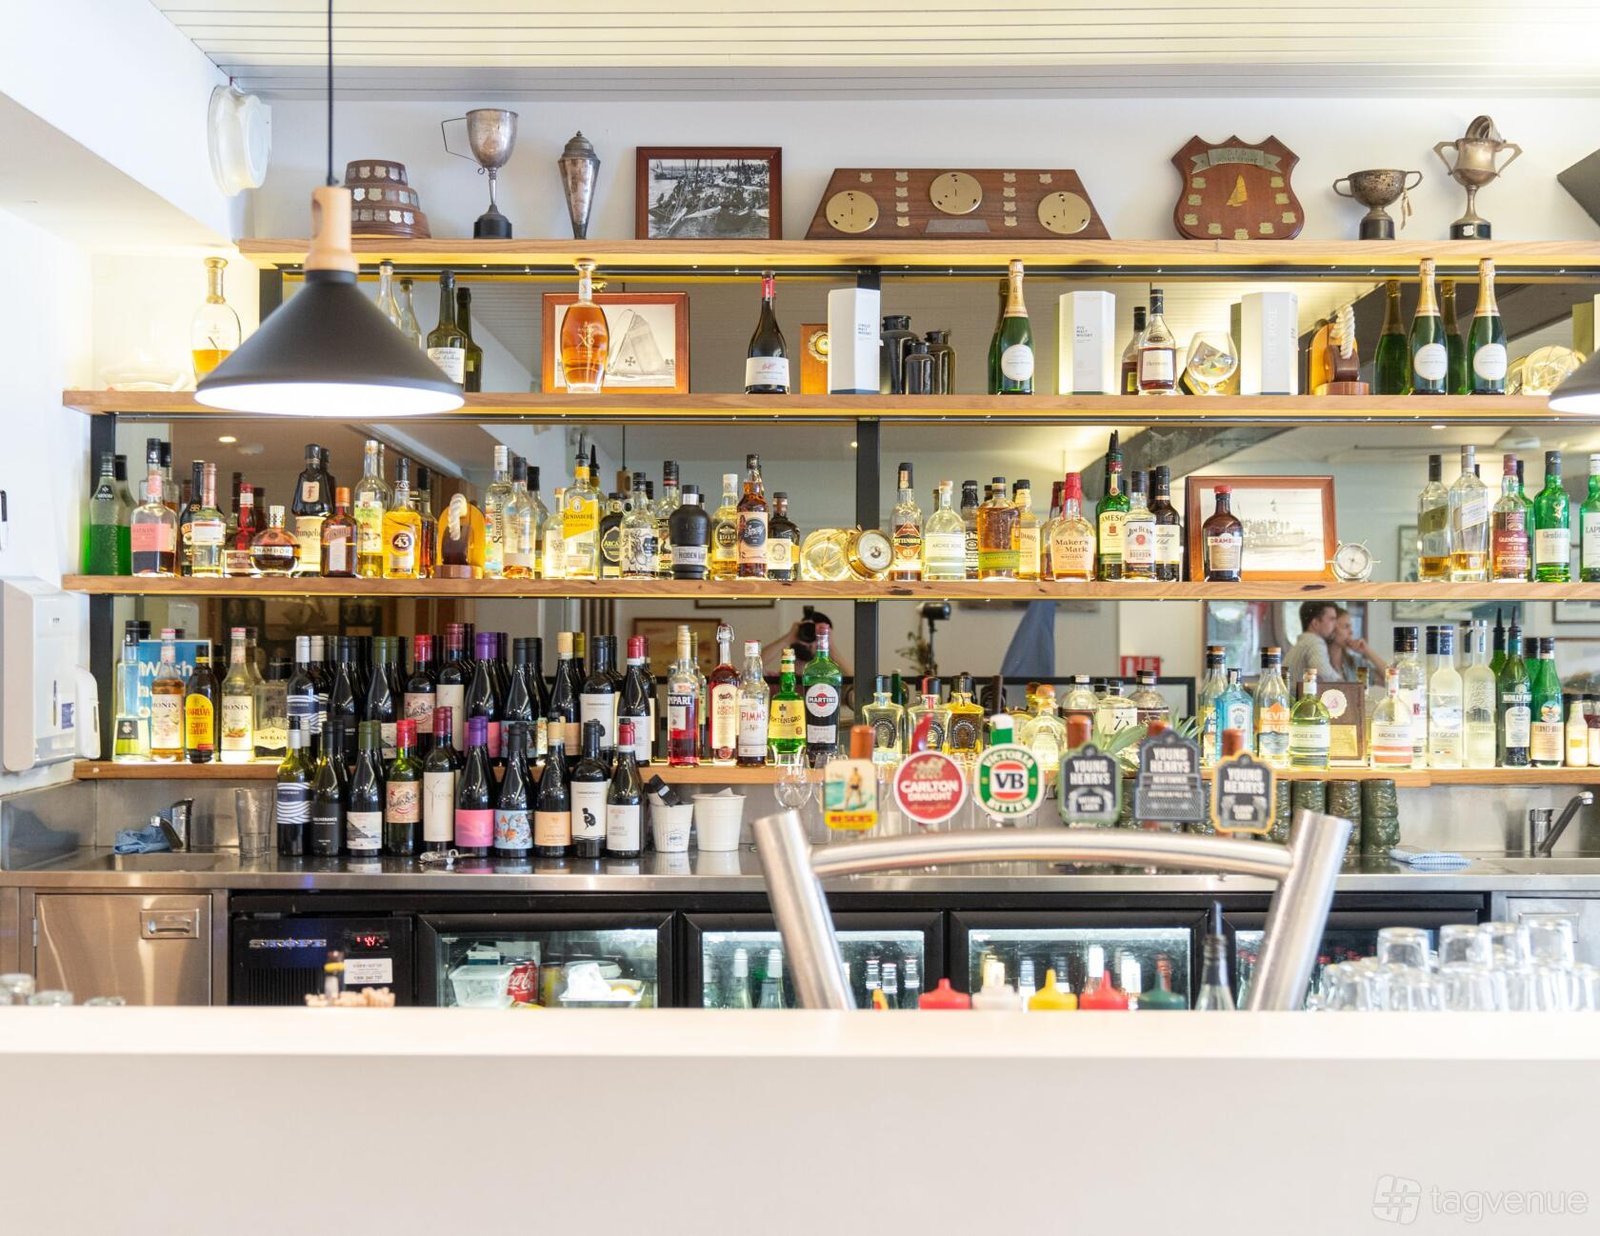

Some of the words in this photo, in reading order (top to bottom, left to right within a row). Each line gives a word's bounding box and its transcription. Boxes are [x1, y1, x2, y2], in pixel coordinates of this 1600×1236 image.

[393, 537, 411, 549] 43
[139, 660, 194, 677] Wsh
[808, 696, 836, 704] MARTINI
[982, 749, 1035, 769] VICTORIA
[1152, 747, 1188, 760] YOUNG
[1072, 759, 1108, 773] YOUNG
[1150, 760, 1191, 773] HENRYS
[994, 772, 1024, 789] VB
[1069, 772, 1111, 785] HENRYS
[1226, 768, 1263, 781] YOUNG
[900, 780, 959, 793] CARLTON
[1223, 780, 1265, 794] HENRYS
